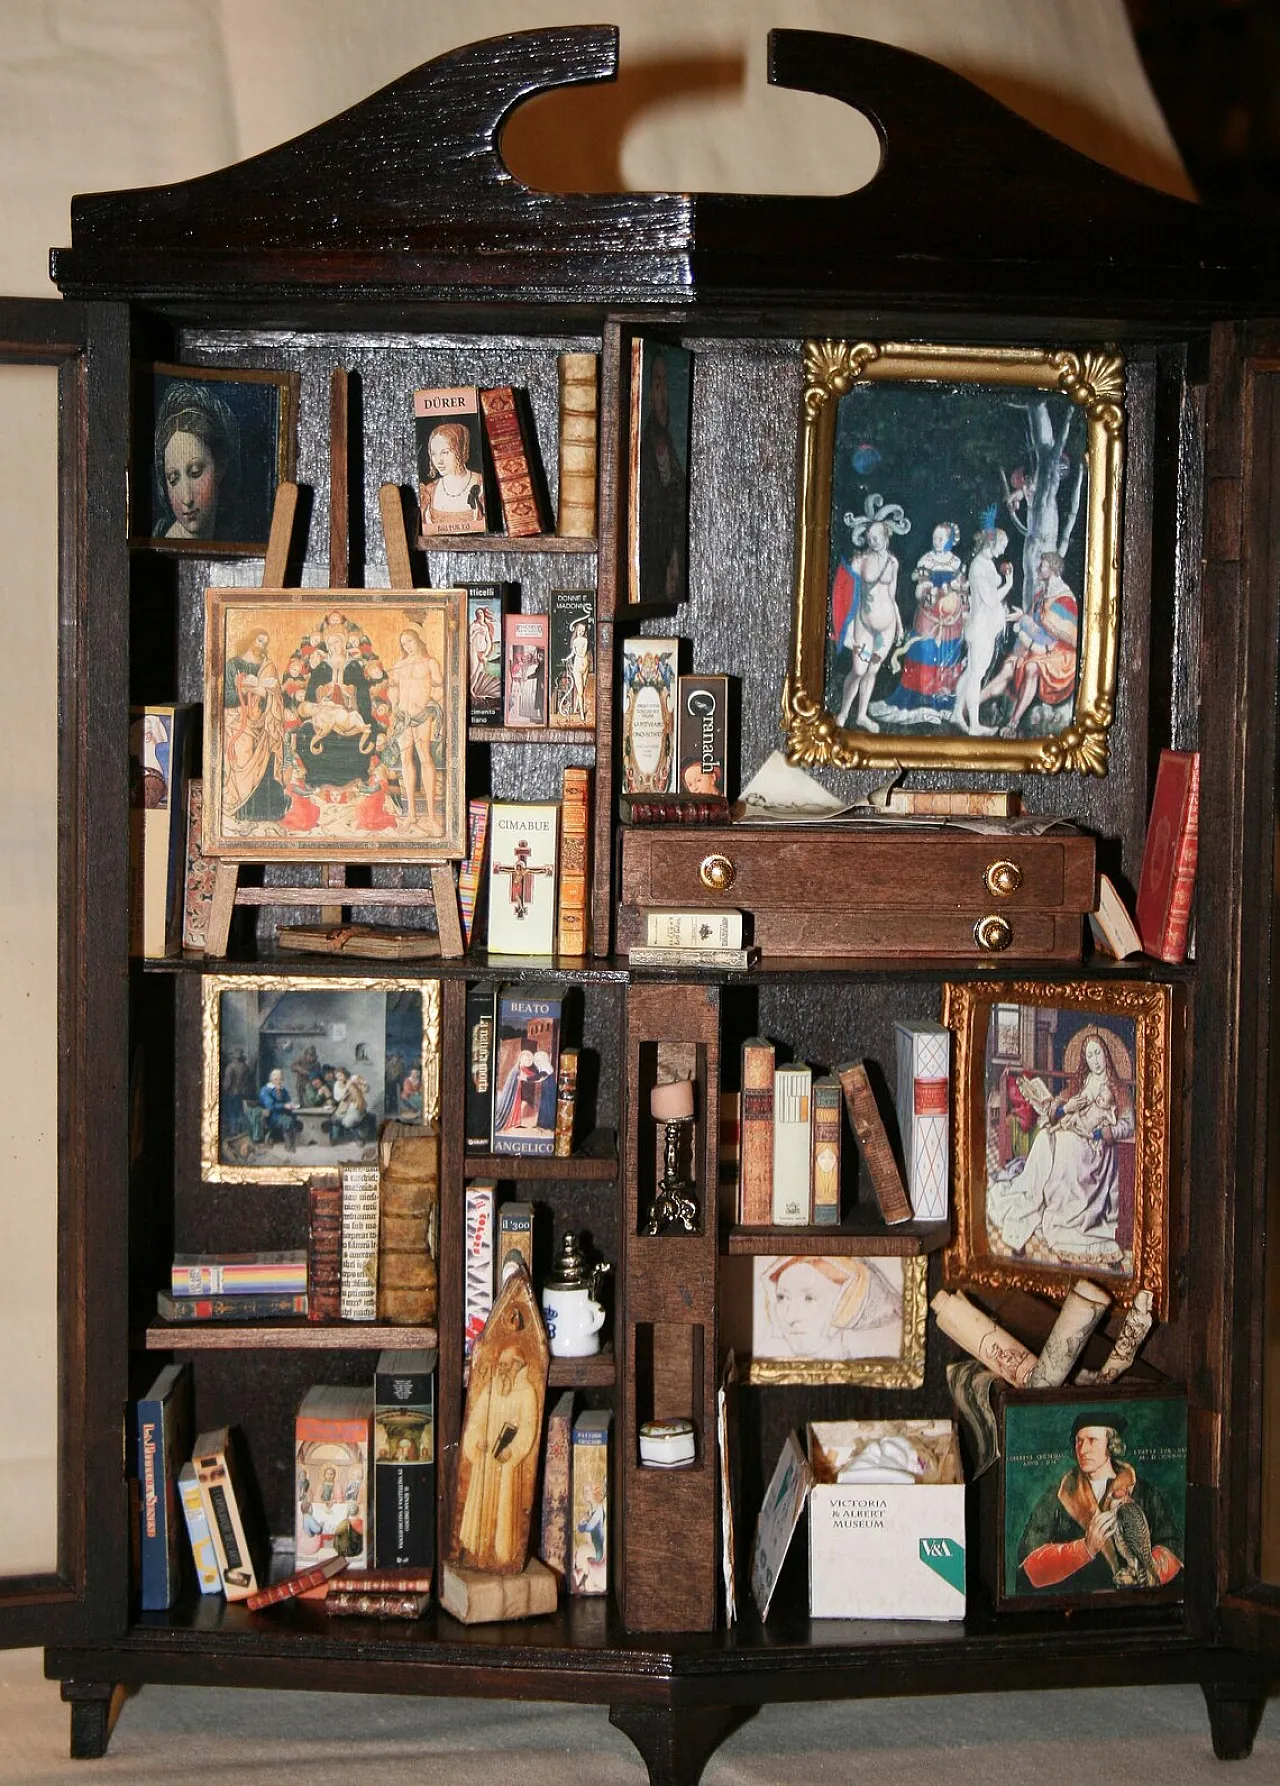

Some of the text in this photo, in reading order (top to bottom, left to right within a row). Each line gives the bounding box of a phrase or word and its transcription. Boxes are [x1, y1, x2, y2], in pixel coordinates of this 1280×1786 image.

[424, 396, 466, 410] DÜRER
[470, 588, 495, 597] tticelli
[471, 708, 496, 716] cimento
[688, 690, 721, 774] Cranach
[498, 820, 550, 831] CIMABUE
[511, 1003, 550, 1014] BEATO
[478, 1015, 492, 1093] La natura morta
[495, 1141, 555, 1153] ANGELICO
[502, 1218, 530, 1231] il '300
[830, 1500, 887, 1508] VICTORIA
[832, 1510, 886, 1518] & ALBERT
[833, 1520, 884, 1529] MUSEUM
[922, 1540, 953, 1557] V&A
